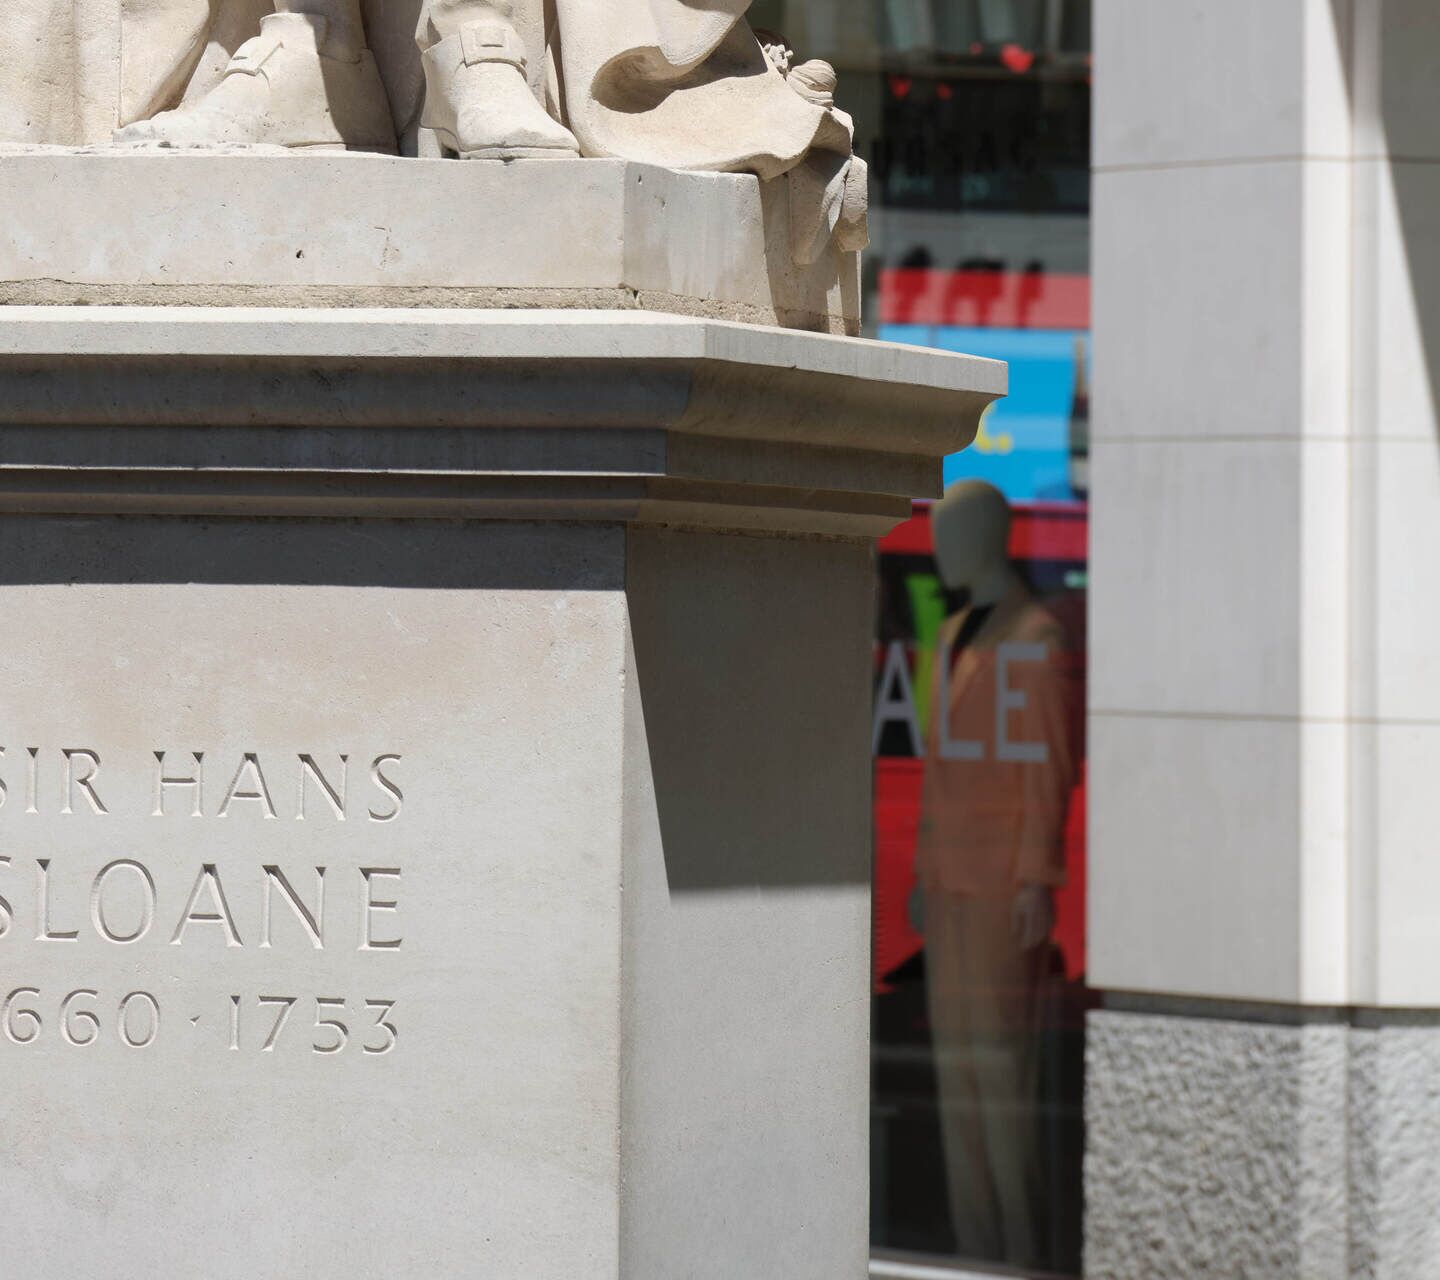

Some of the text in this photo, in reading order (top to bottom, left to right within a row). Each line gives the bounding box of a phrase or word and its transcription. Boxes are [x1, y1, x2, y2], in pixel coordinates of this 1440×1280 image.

[872, 639, 1048, 764] ALE
[152, 750, 406, 824] HANS
[228, 994, 400, 1056] 1753
